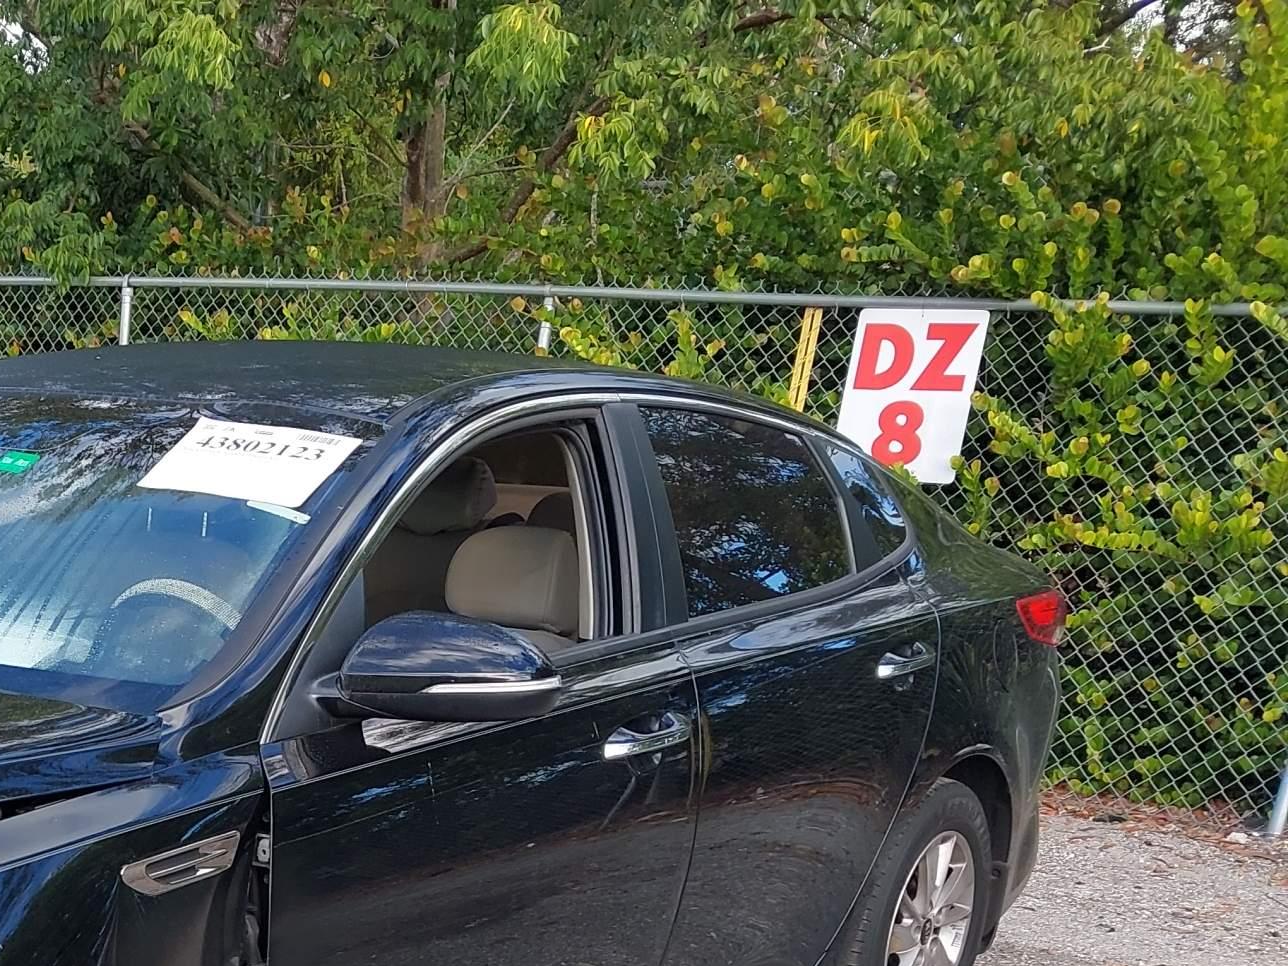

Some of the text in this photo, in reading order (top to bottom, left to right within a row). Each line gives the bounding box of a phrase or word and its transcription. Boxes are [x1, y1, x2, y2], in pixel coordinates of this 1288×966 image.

[853, 322, 981, 392] DZ
[195, 434, 326, 461] 43802123
[871, 400, 924, 467] 8
